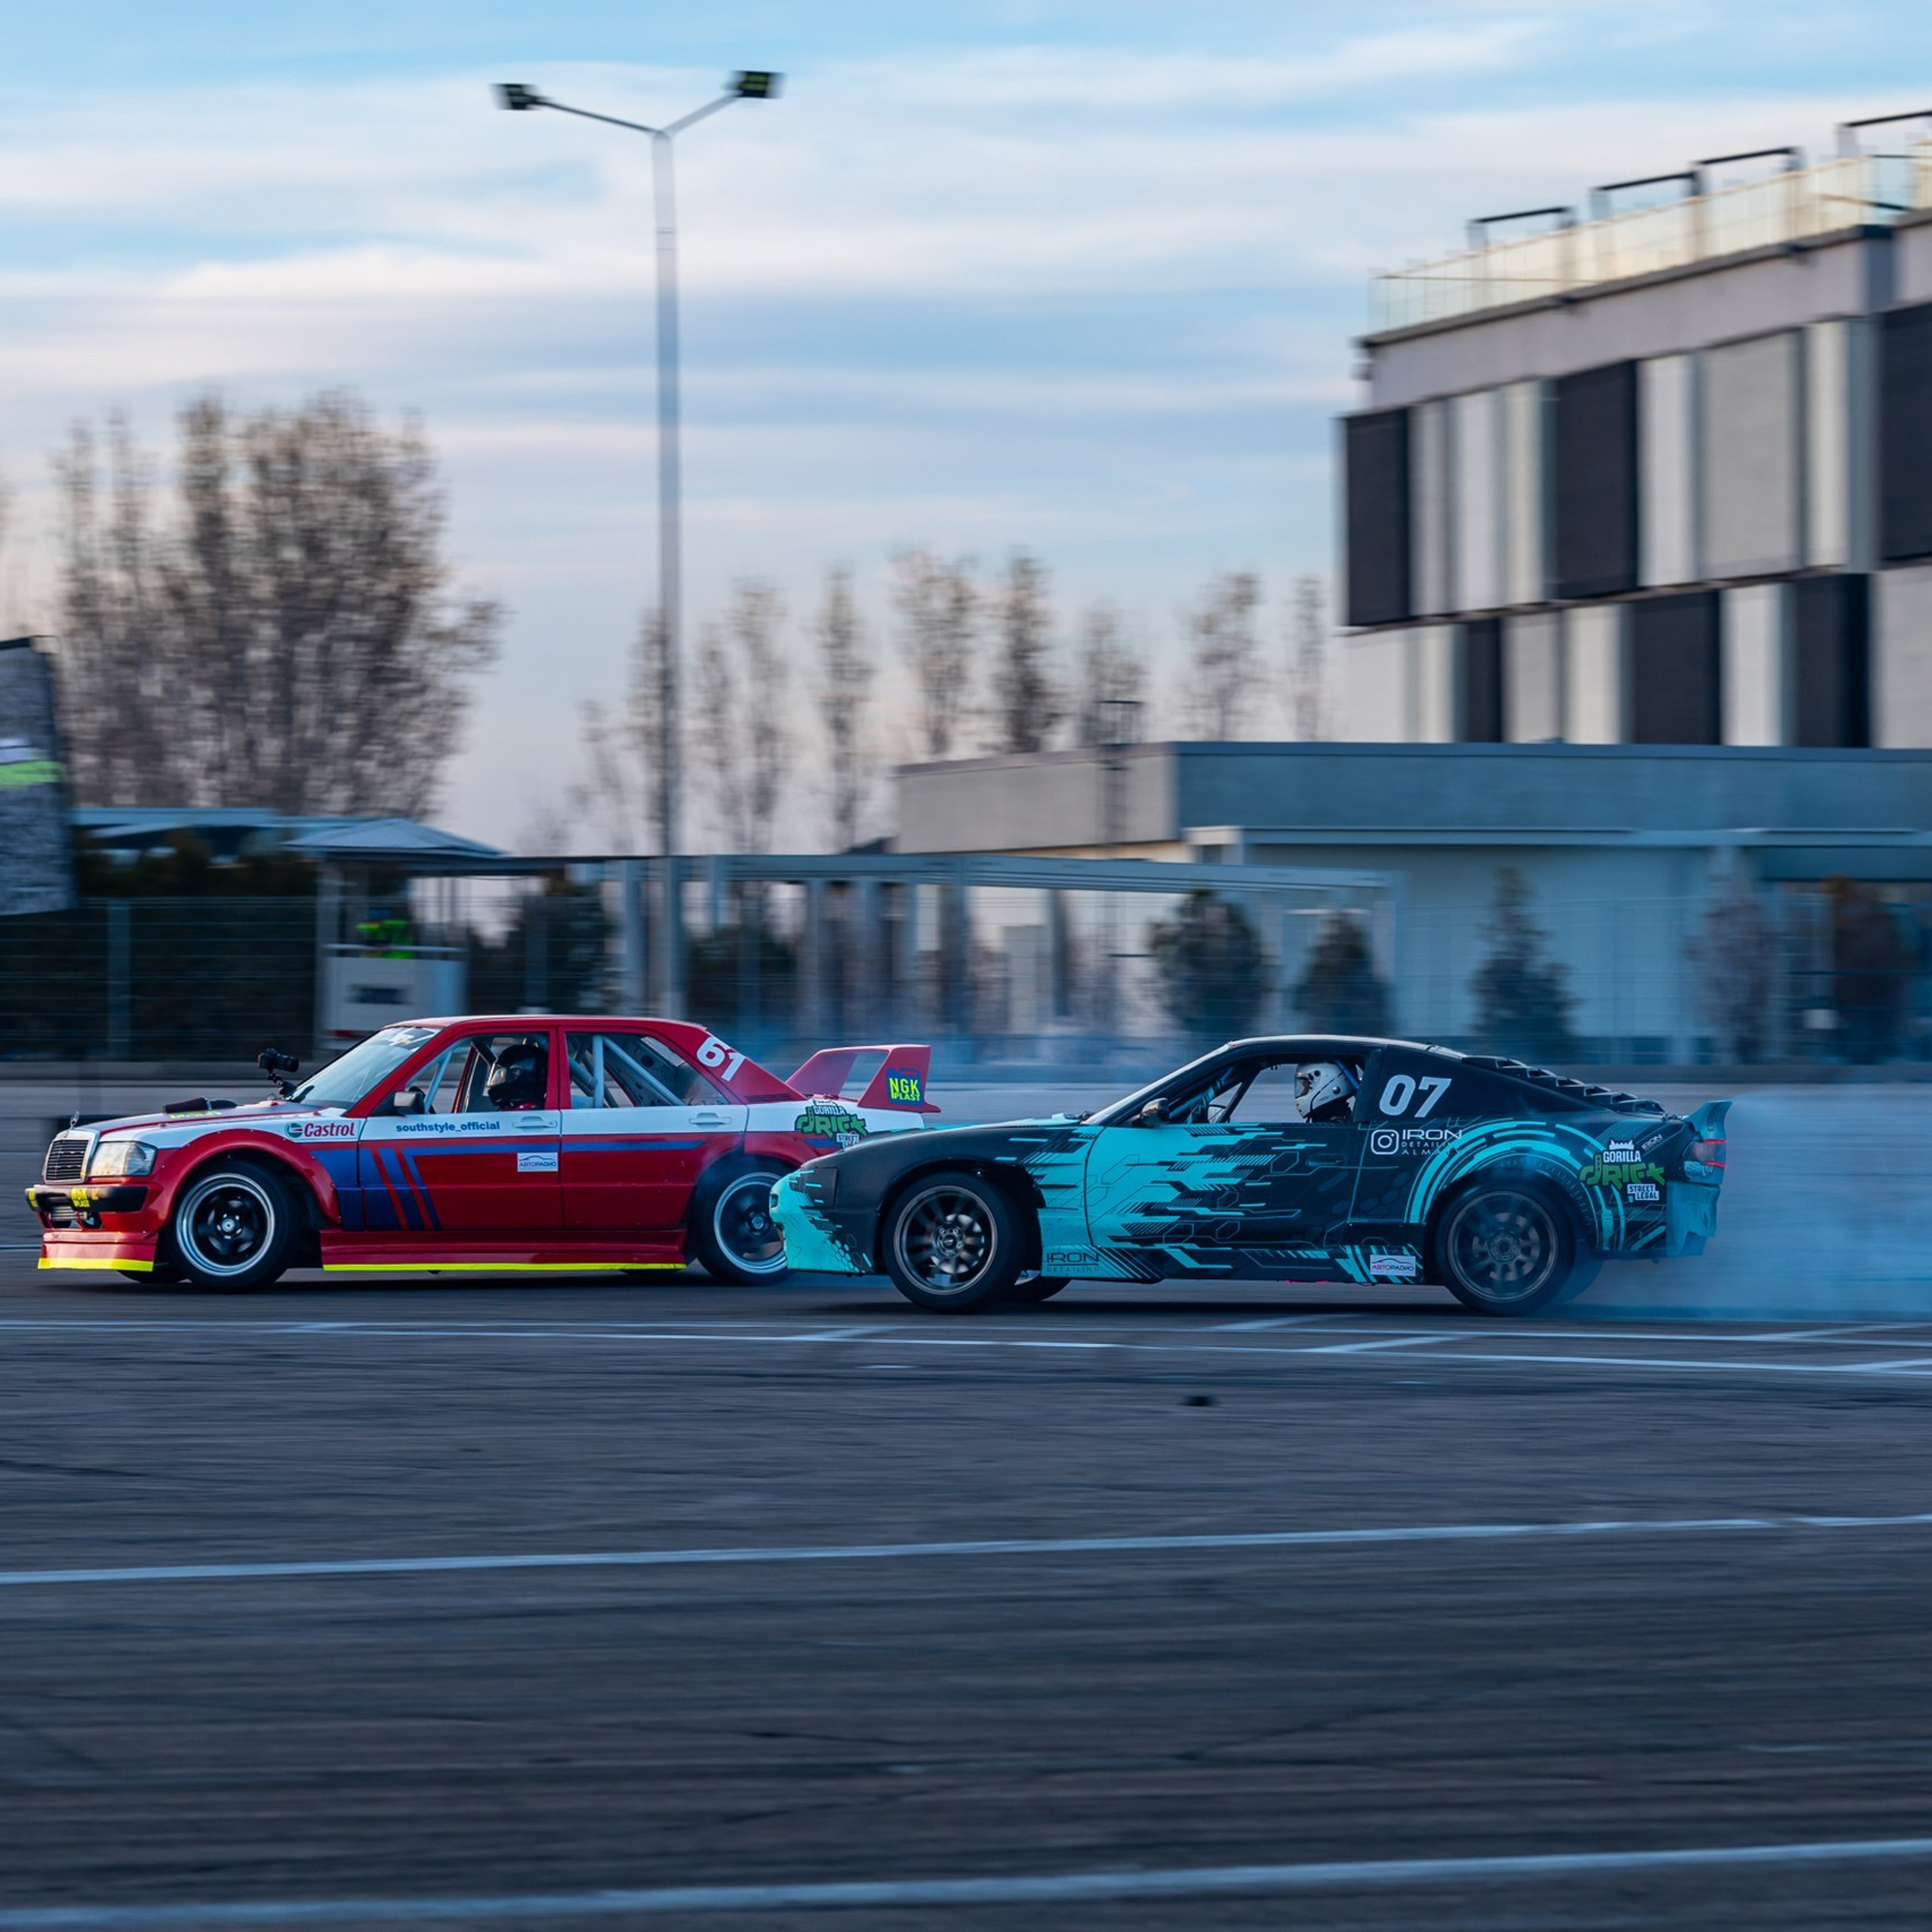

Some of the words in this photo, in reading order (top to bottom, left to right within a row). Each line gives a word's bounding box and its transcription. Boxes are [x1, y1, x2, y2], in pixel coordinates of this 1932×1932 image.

[697, 1036, 746, 1082] 61
[889, 1077, 920, 1097] NGK
[892, 1092, 920, 1101] PLAST
[1379, 1075, 1452, 1118] 07
[814, 1106, 846, 1115] GORILLA
[304, 1122, 355, 1137] Castrol
[396, 1121, 500, 1133] southstyle_official
[1402, 1129, 1463, 1140] IRON
[1603, 1150, 1641, 1162] GORILLA
[1629, 1185, 1655, 1193] STREET
[1636, 1192, 1659, 1200] LEGAL
[1047, 1252, 1099, 1263] IRON
